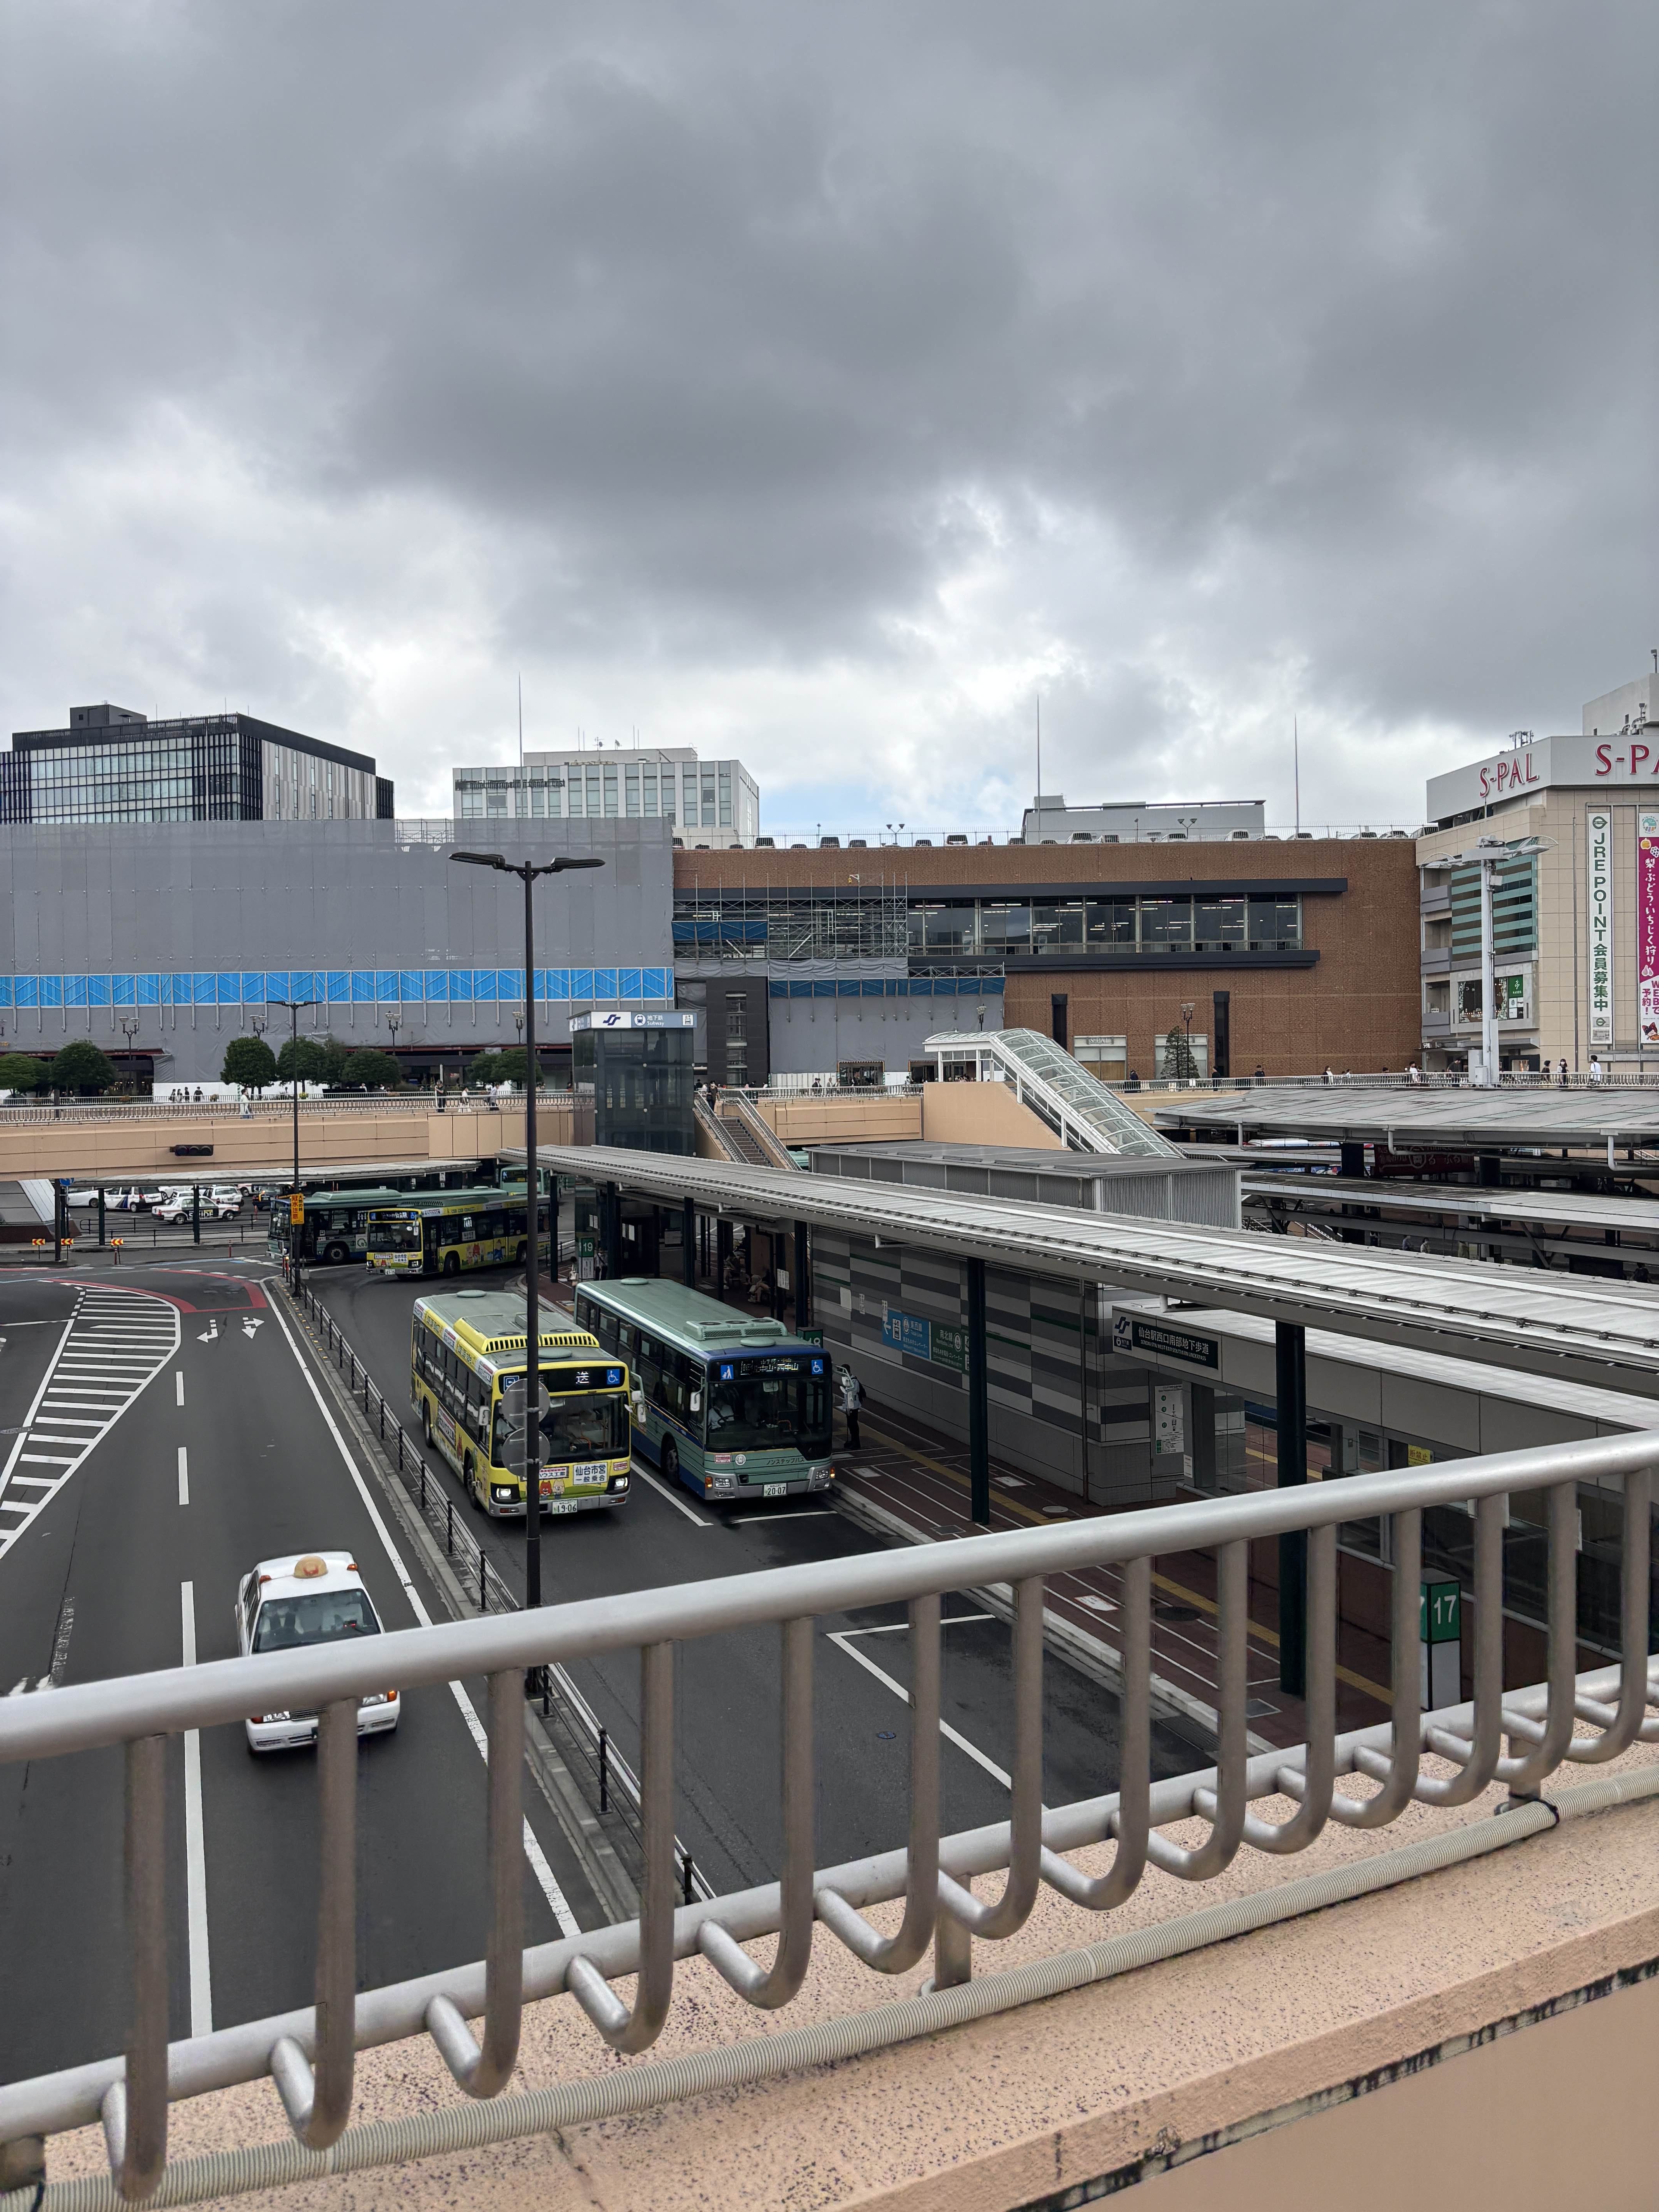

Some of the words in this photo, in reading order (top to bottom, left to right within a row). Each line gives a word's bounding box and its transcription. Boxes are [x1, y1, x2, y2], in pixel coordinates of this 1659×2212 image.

[1480, 753, 1540, 797] S-PAL
[1594, 833, 1606, 871] JRE
[583, 1242, 593, 1252] 19
[1139, 1326, 1209, 1355] 仙台駅西口南部地下歩道
[575, 1465, 606, 1476] 仙台市営
[1434, 1595, 1456, 1624] 17
